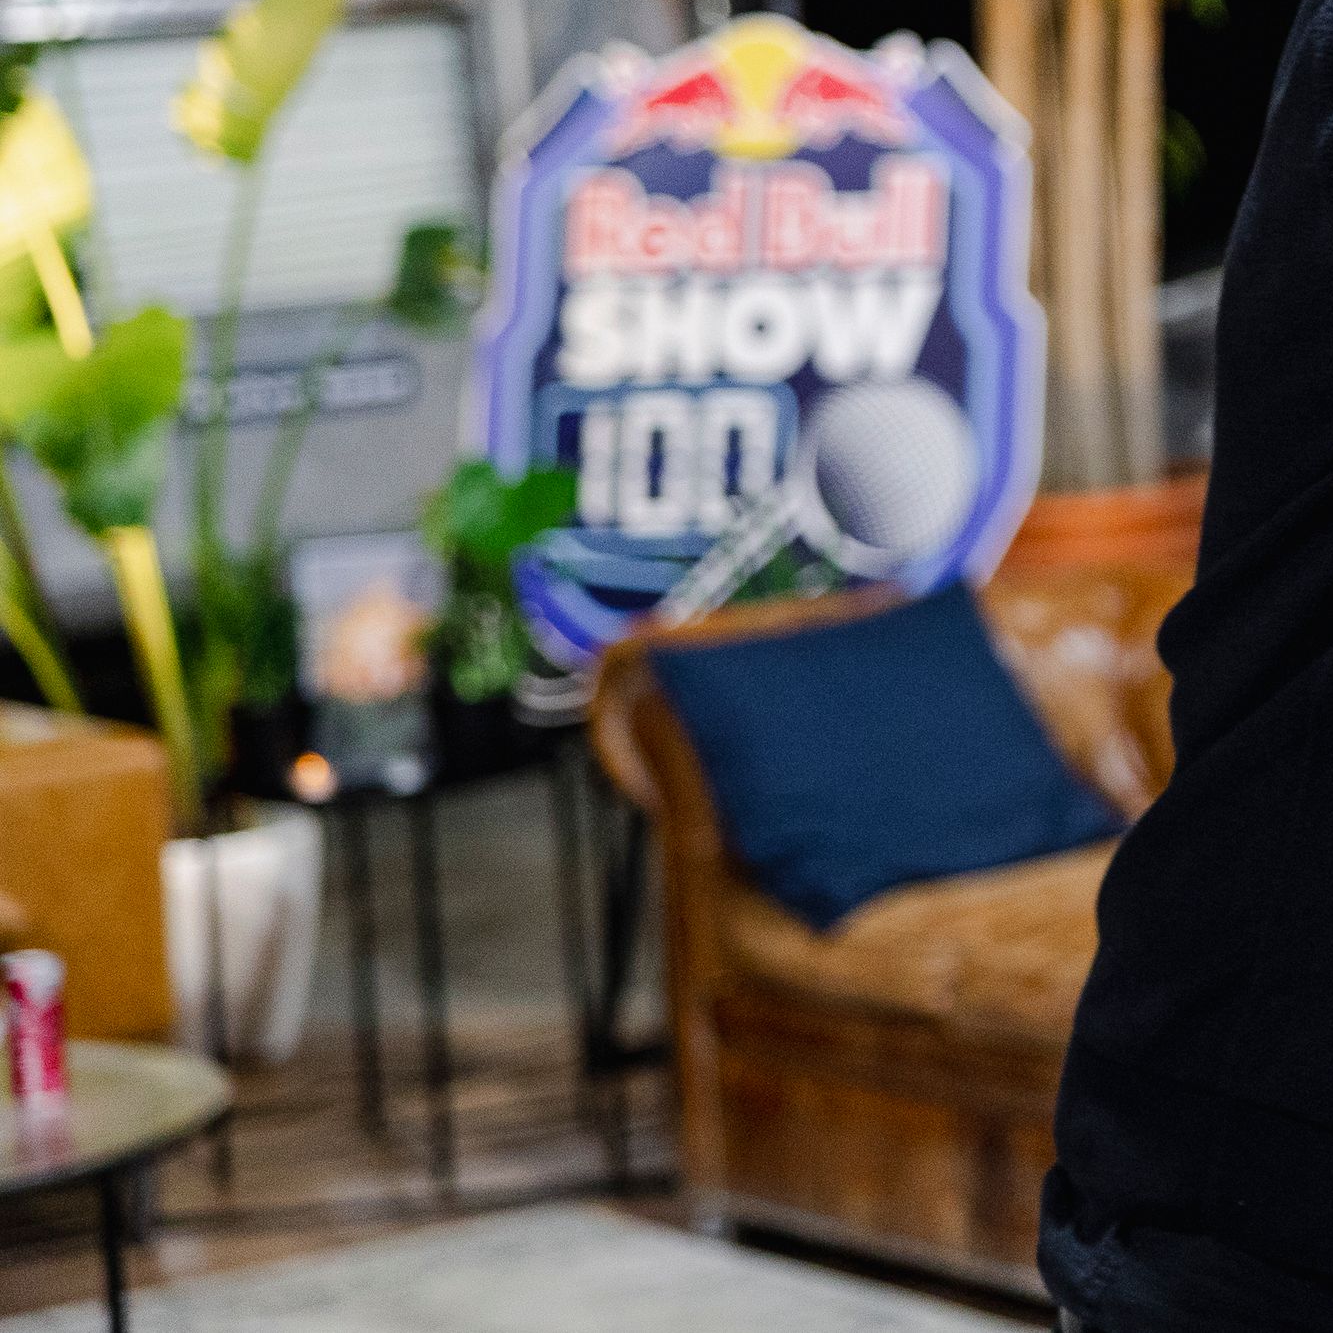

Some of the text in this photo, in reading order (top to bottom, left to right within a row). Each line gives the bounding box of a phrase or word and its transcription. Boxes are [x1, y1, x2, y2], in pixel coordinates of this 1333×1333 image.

[567, 156, 950, 272] Red Bull
[561, 276, 944, 385] SHOW
[579, 389, 779, 537] 100
